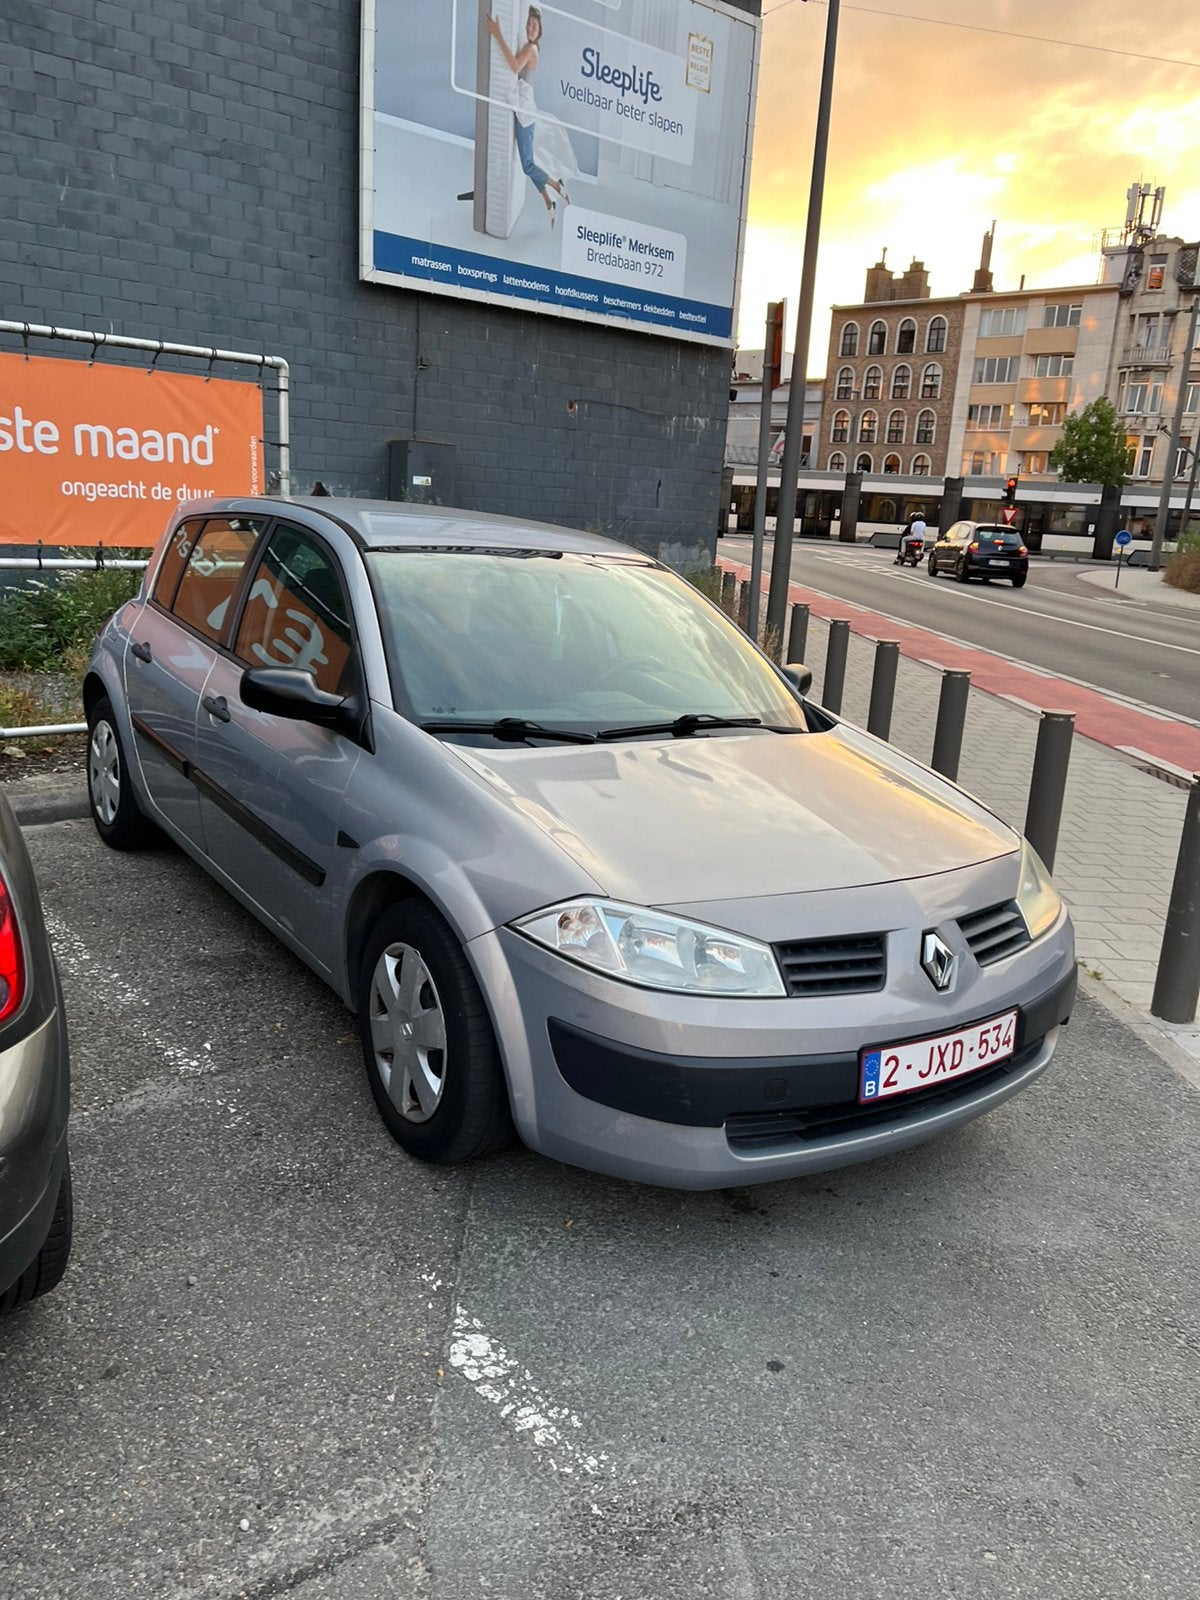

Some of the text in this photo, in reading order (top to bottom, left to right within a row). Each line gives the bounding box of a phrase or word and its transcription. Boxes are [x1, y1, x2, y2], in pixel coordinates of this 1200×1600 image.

[691, 43, 710, 58] BESTE
[581, 47, 662, 104] Sleeplife
[561, 79, 683, 136] Voelbaar beter slapen
[587, 248, 664, 278] Bredabaan 972
[628, 238, 675, 261] Merksem
[411, 256, 707, 324] matrassen boxsprings lattenbodems hoofdkussens beschermers dekbedden bedtextiel
[248, 435, 258, 484] voorwaarden
[61, 480, 147, 502] ongeacht
[150, 481, 172, 501] de
[864, 1080, 876, 1097] B
